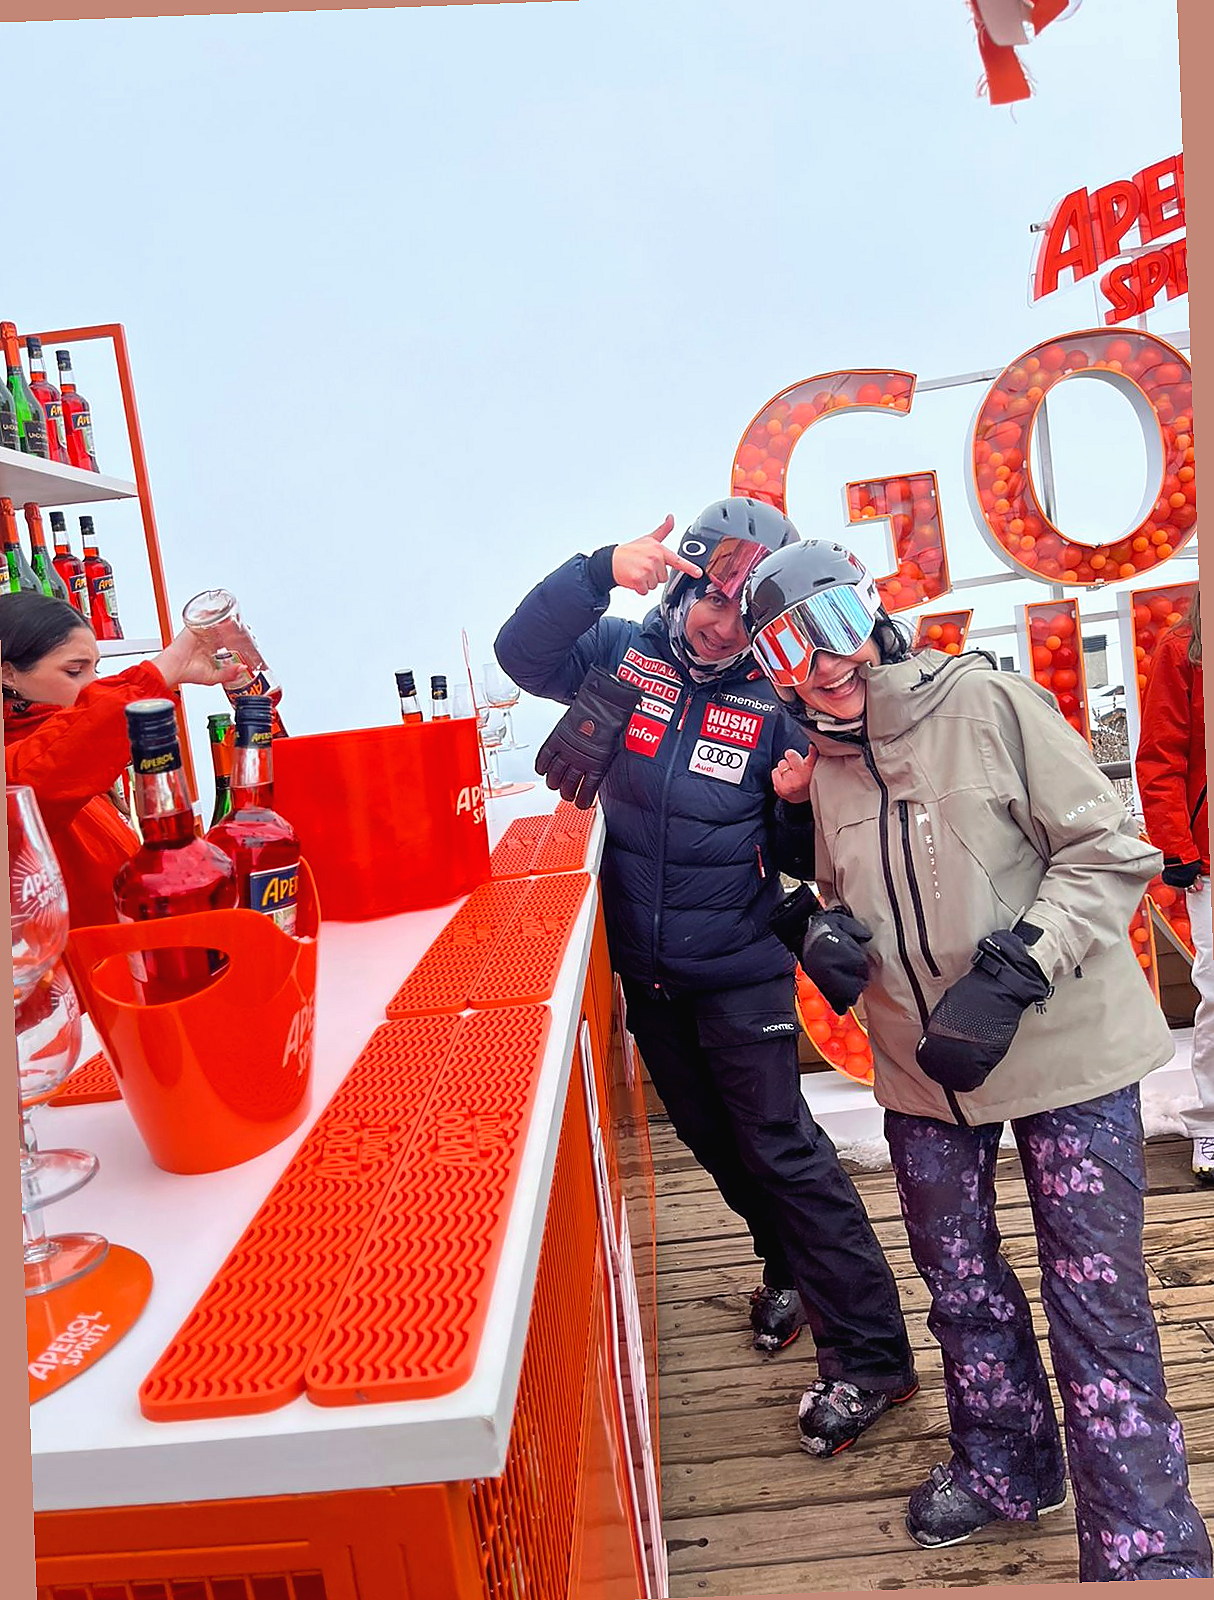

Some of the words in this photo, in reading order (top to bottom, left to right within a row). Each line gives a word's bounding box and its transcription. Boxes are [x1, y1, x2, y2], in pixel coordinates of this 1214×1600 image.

[1034, 152, 1186, 301] APE
[731, 327, 1198, 612] GO
[628, 723, 660, 743] infor
[706, 723, 753, 743] WEAR
[707, 708, 758, 734] HUSKI
[140, 752, 175, 770] APEROL
[694, 762, 715, 774] Audi
[28, 1311, 103, 1381] APEROL
[62, 1323, 111, 1367] SPRITZ
